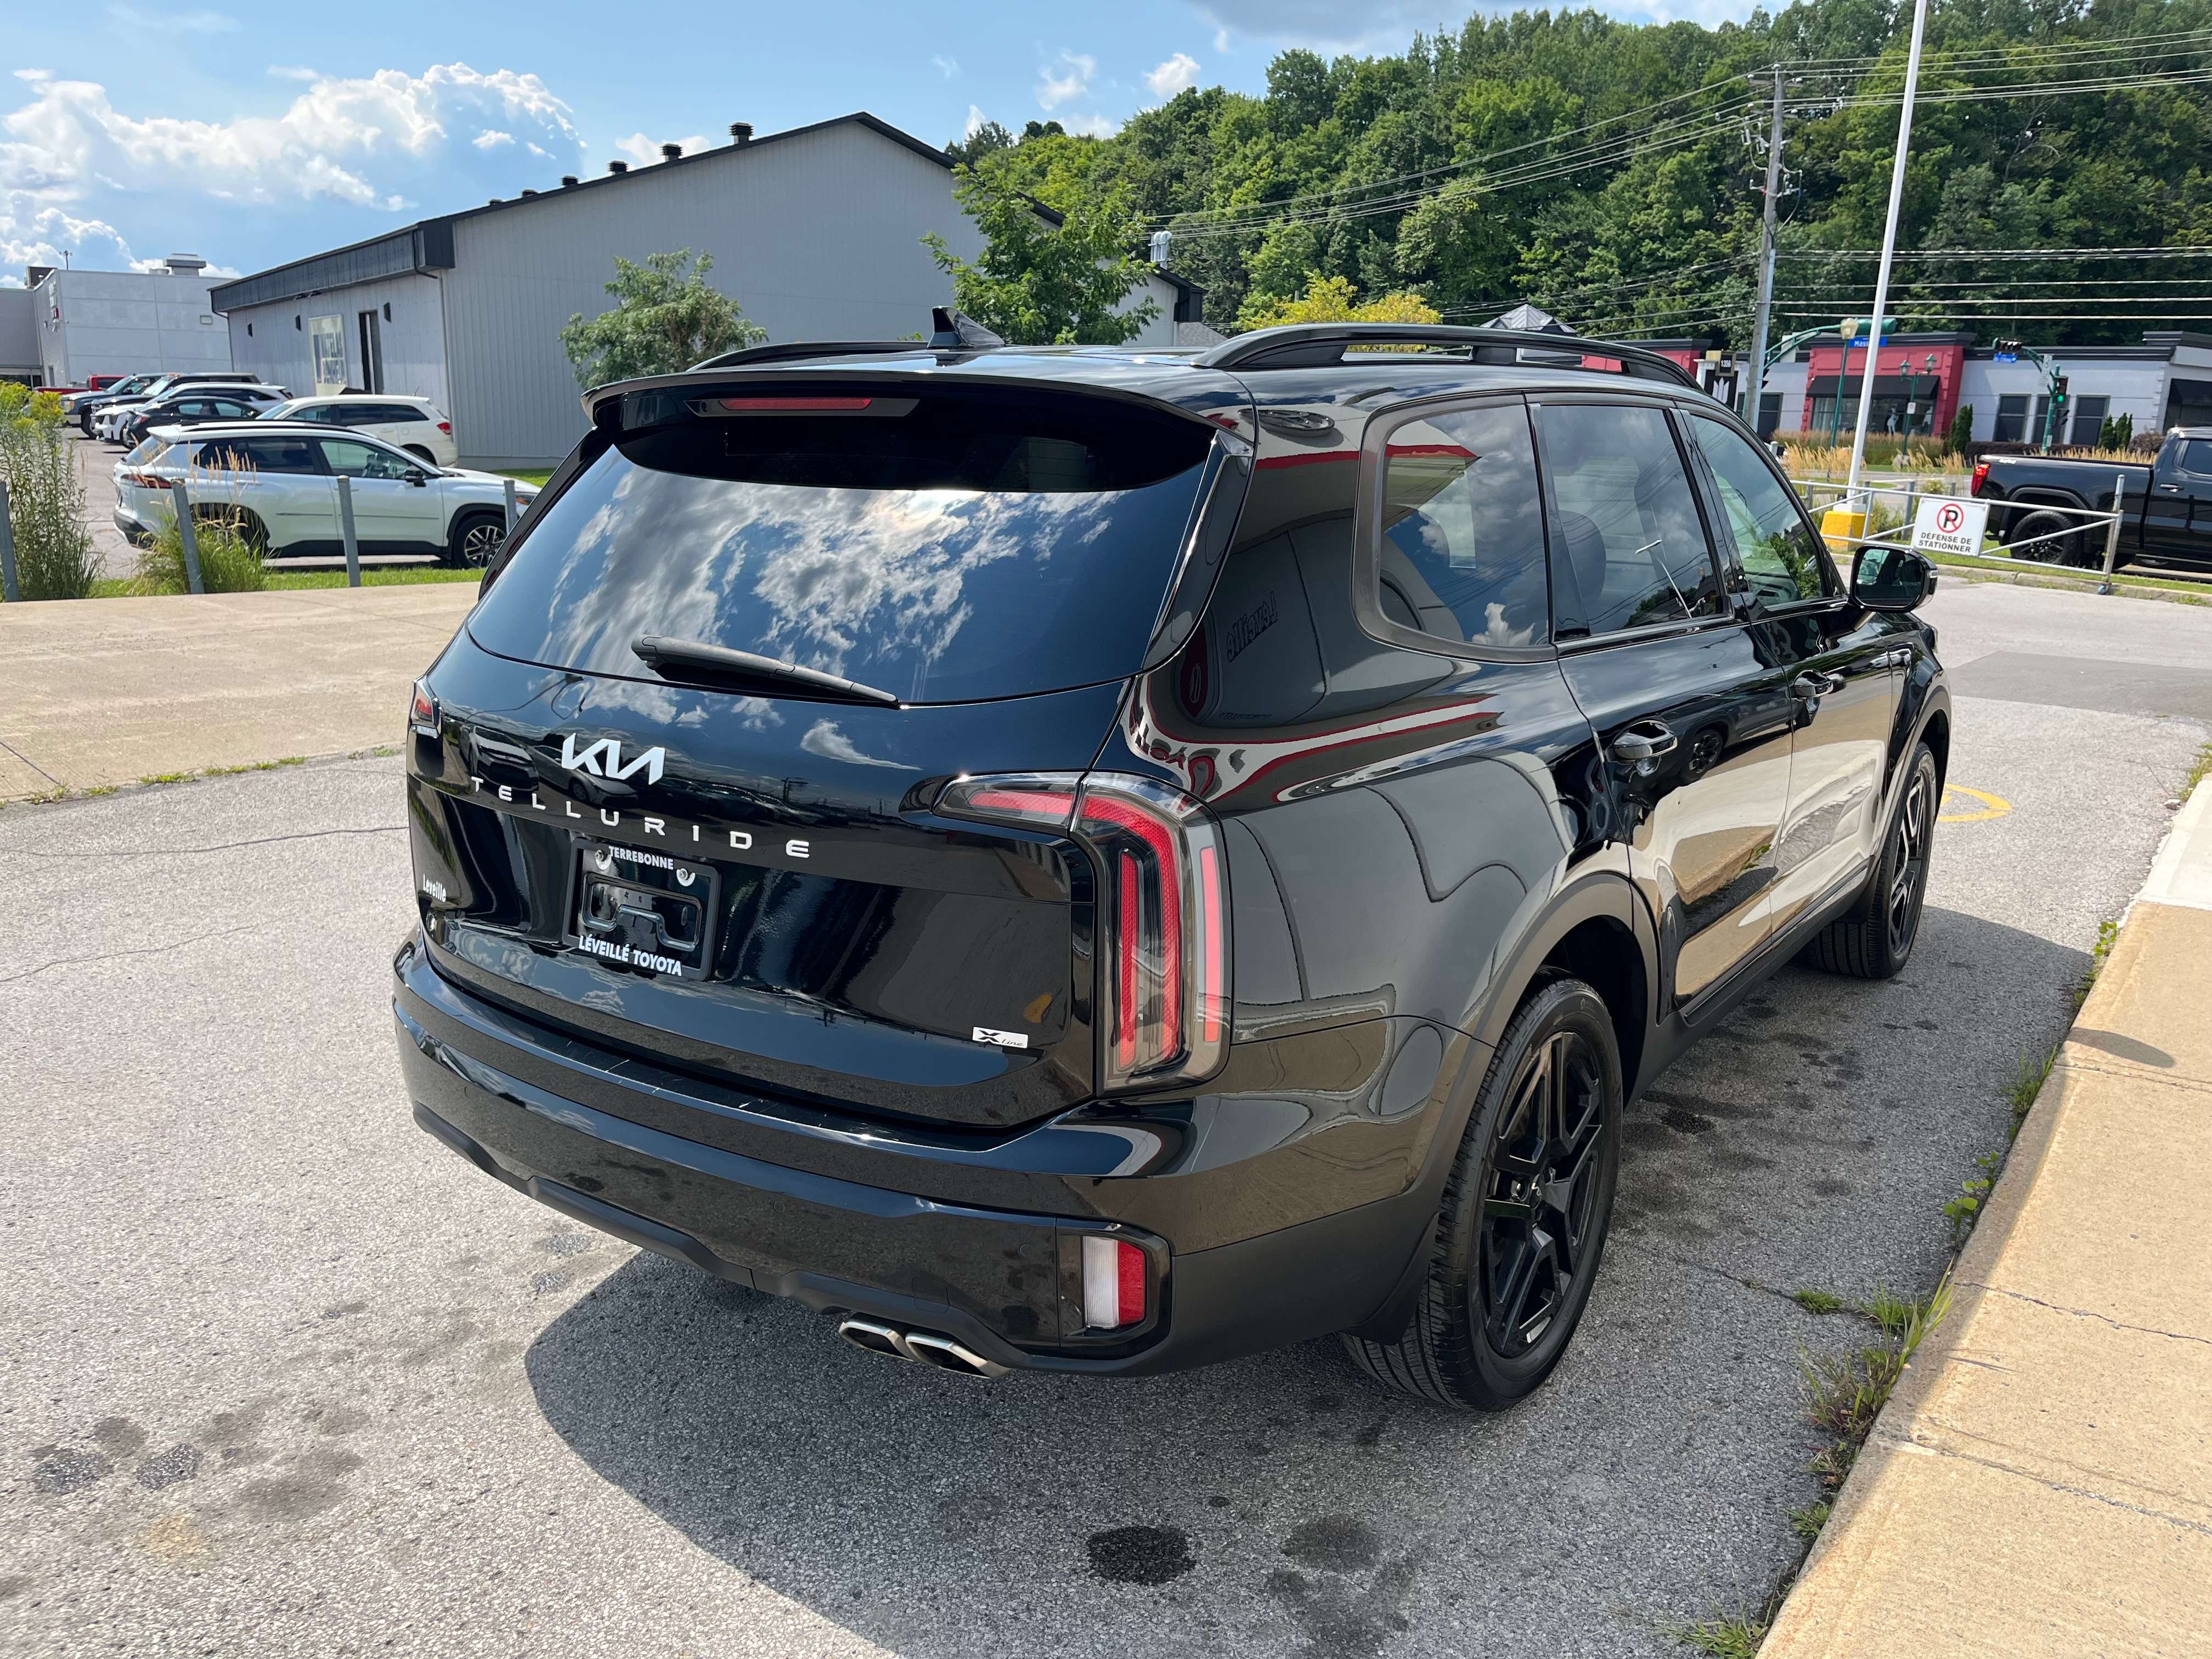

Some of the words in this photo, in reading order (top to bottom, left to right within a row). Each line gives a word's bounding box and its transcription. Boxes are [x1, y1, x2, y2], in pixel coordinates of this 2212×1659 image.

[1918, 540, 1971, 552] STATIONNER
[561, 732, 665, 786] KIA
[471, 776, 810, 859] TELLURIDE
[608, 845, 674, 870] TERREBONNE
[579, 934, 630, 962] LÉVEILLÉ
[633, 949, 682, 977] TOYOTA
